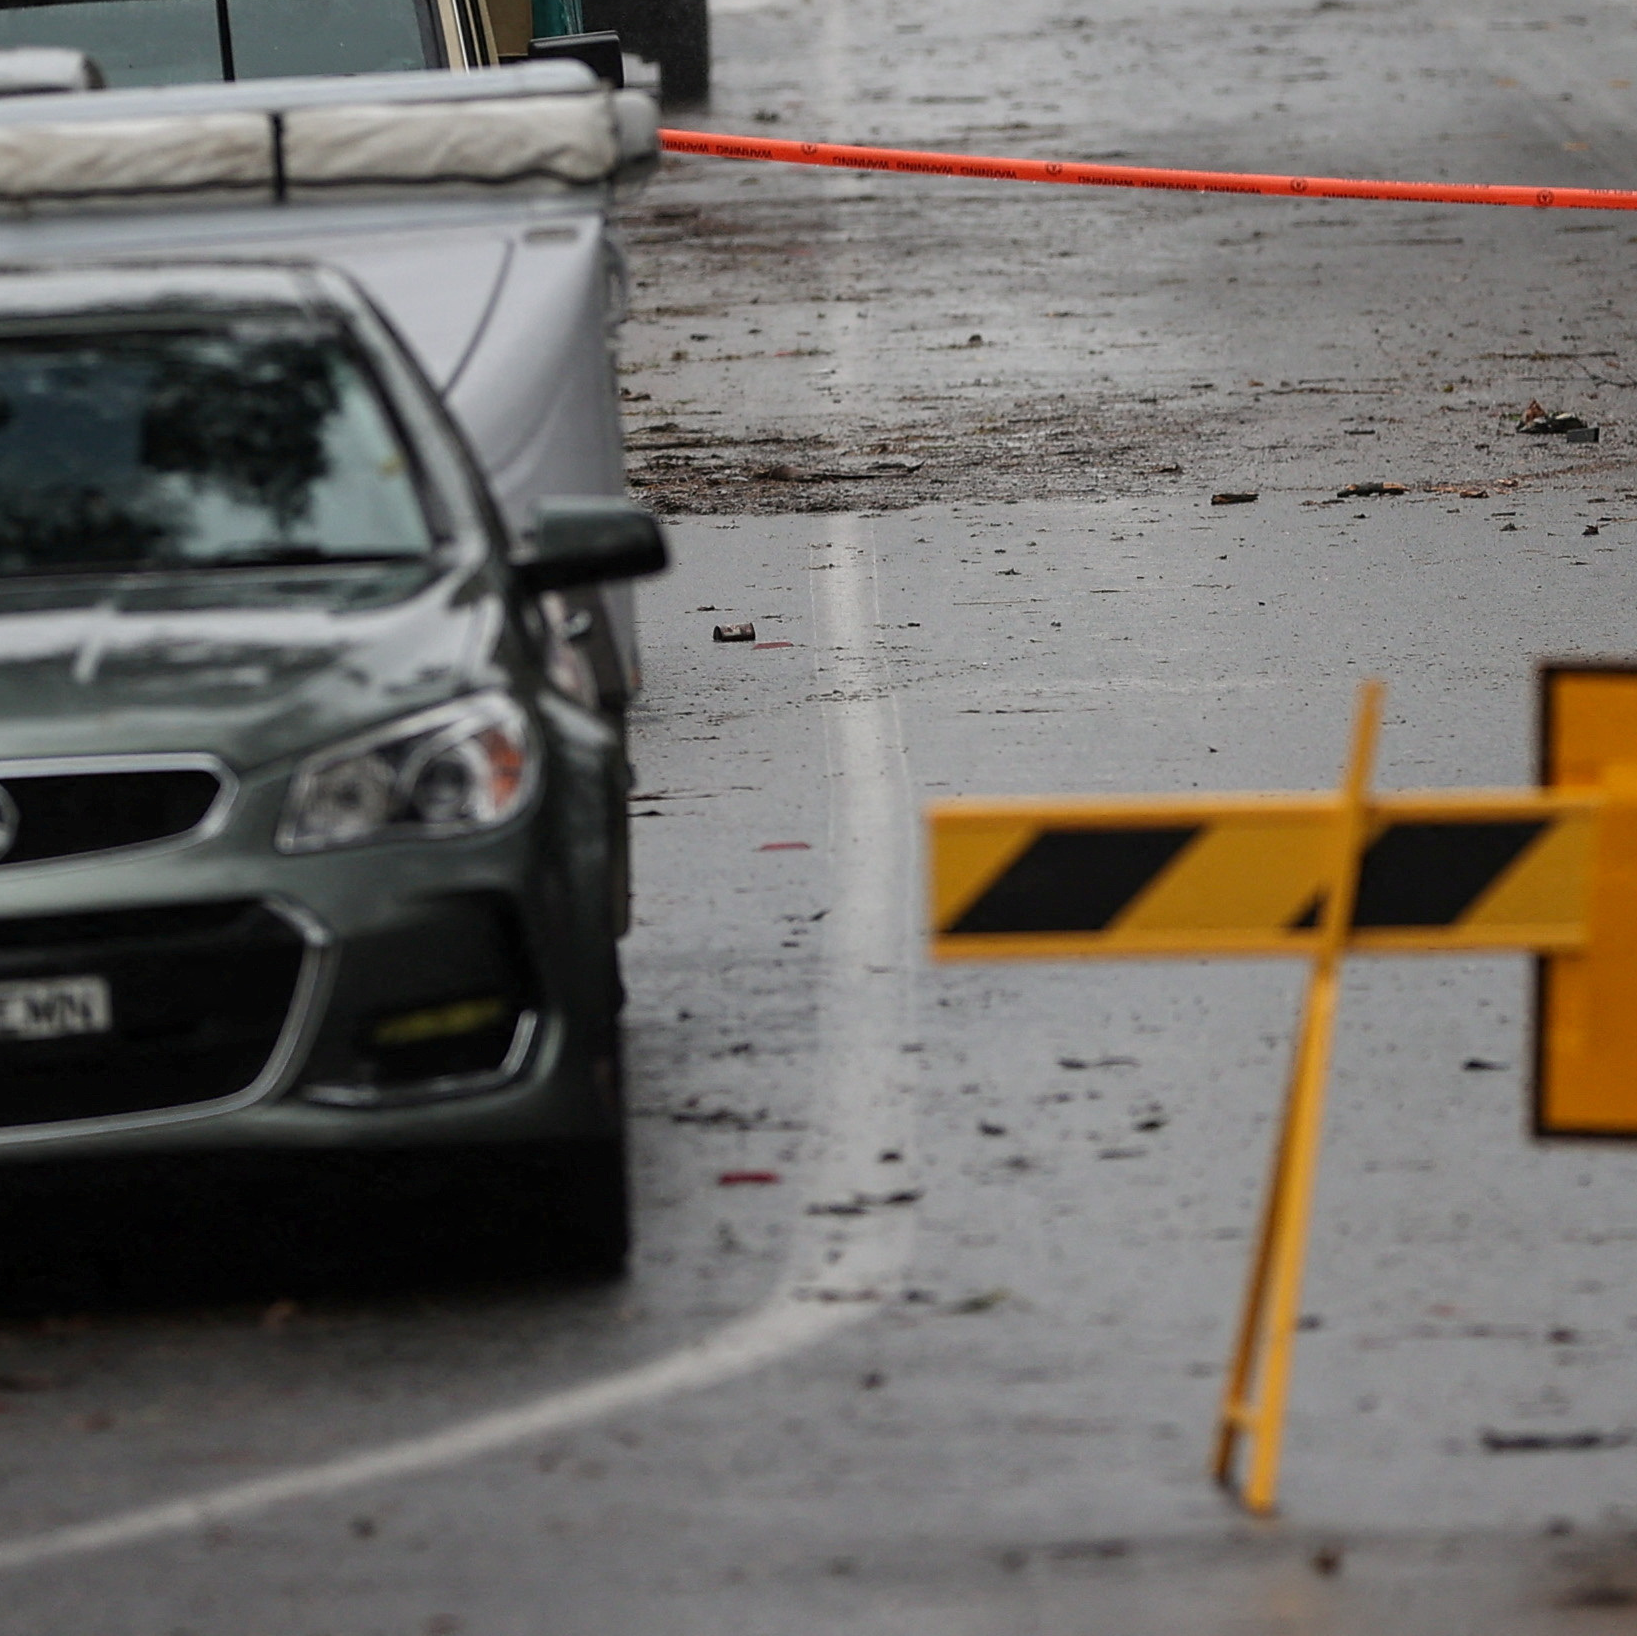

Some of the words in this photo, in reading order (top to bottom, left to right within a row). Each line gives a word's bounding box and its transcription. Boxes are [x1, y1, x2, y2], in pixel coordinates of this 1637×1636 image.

[661, 139, 709, 153] WARNIN
[716, 145, 772, 159] WARNING
[832, 155, 890, 170] WARNING
[896, 160, 953, 174] WARNING
[960, 166, 1017, 179] WARNING
